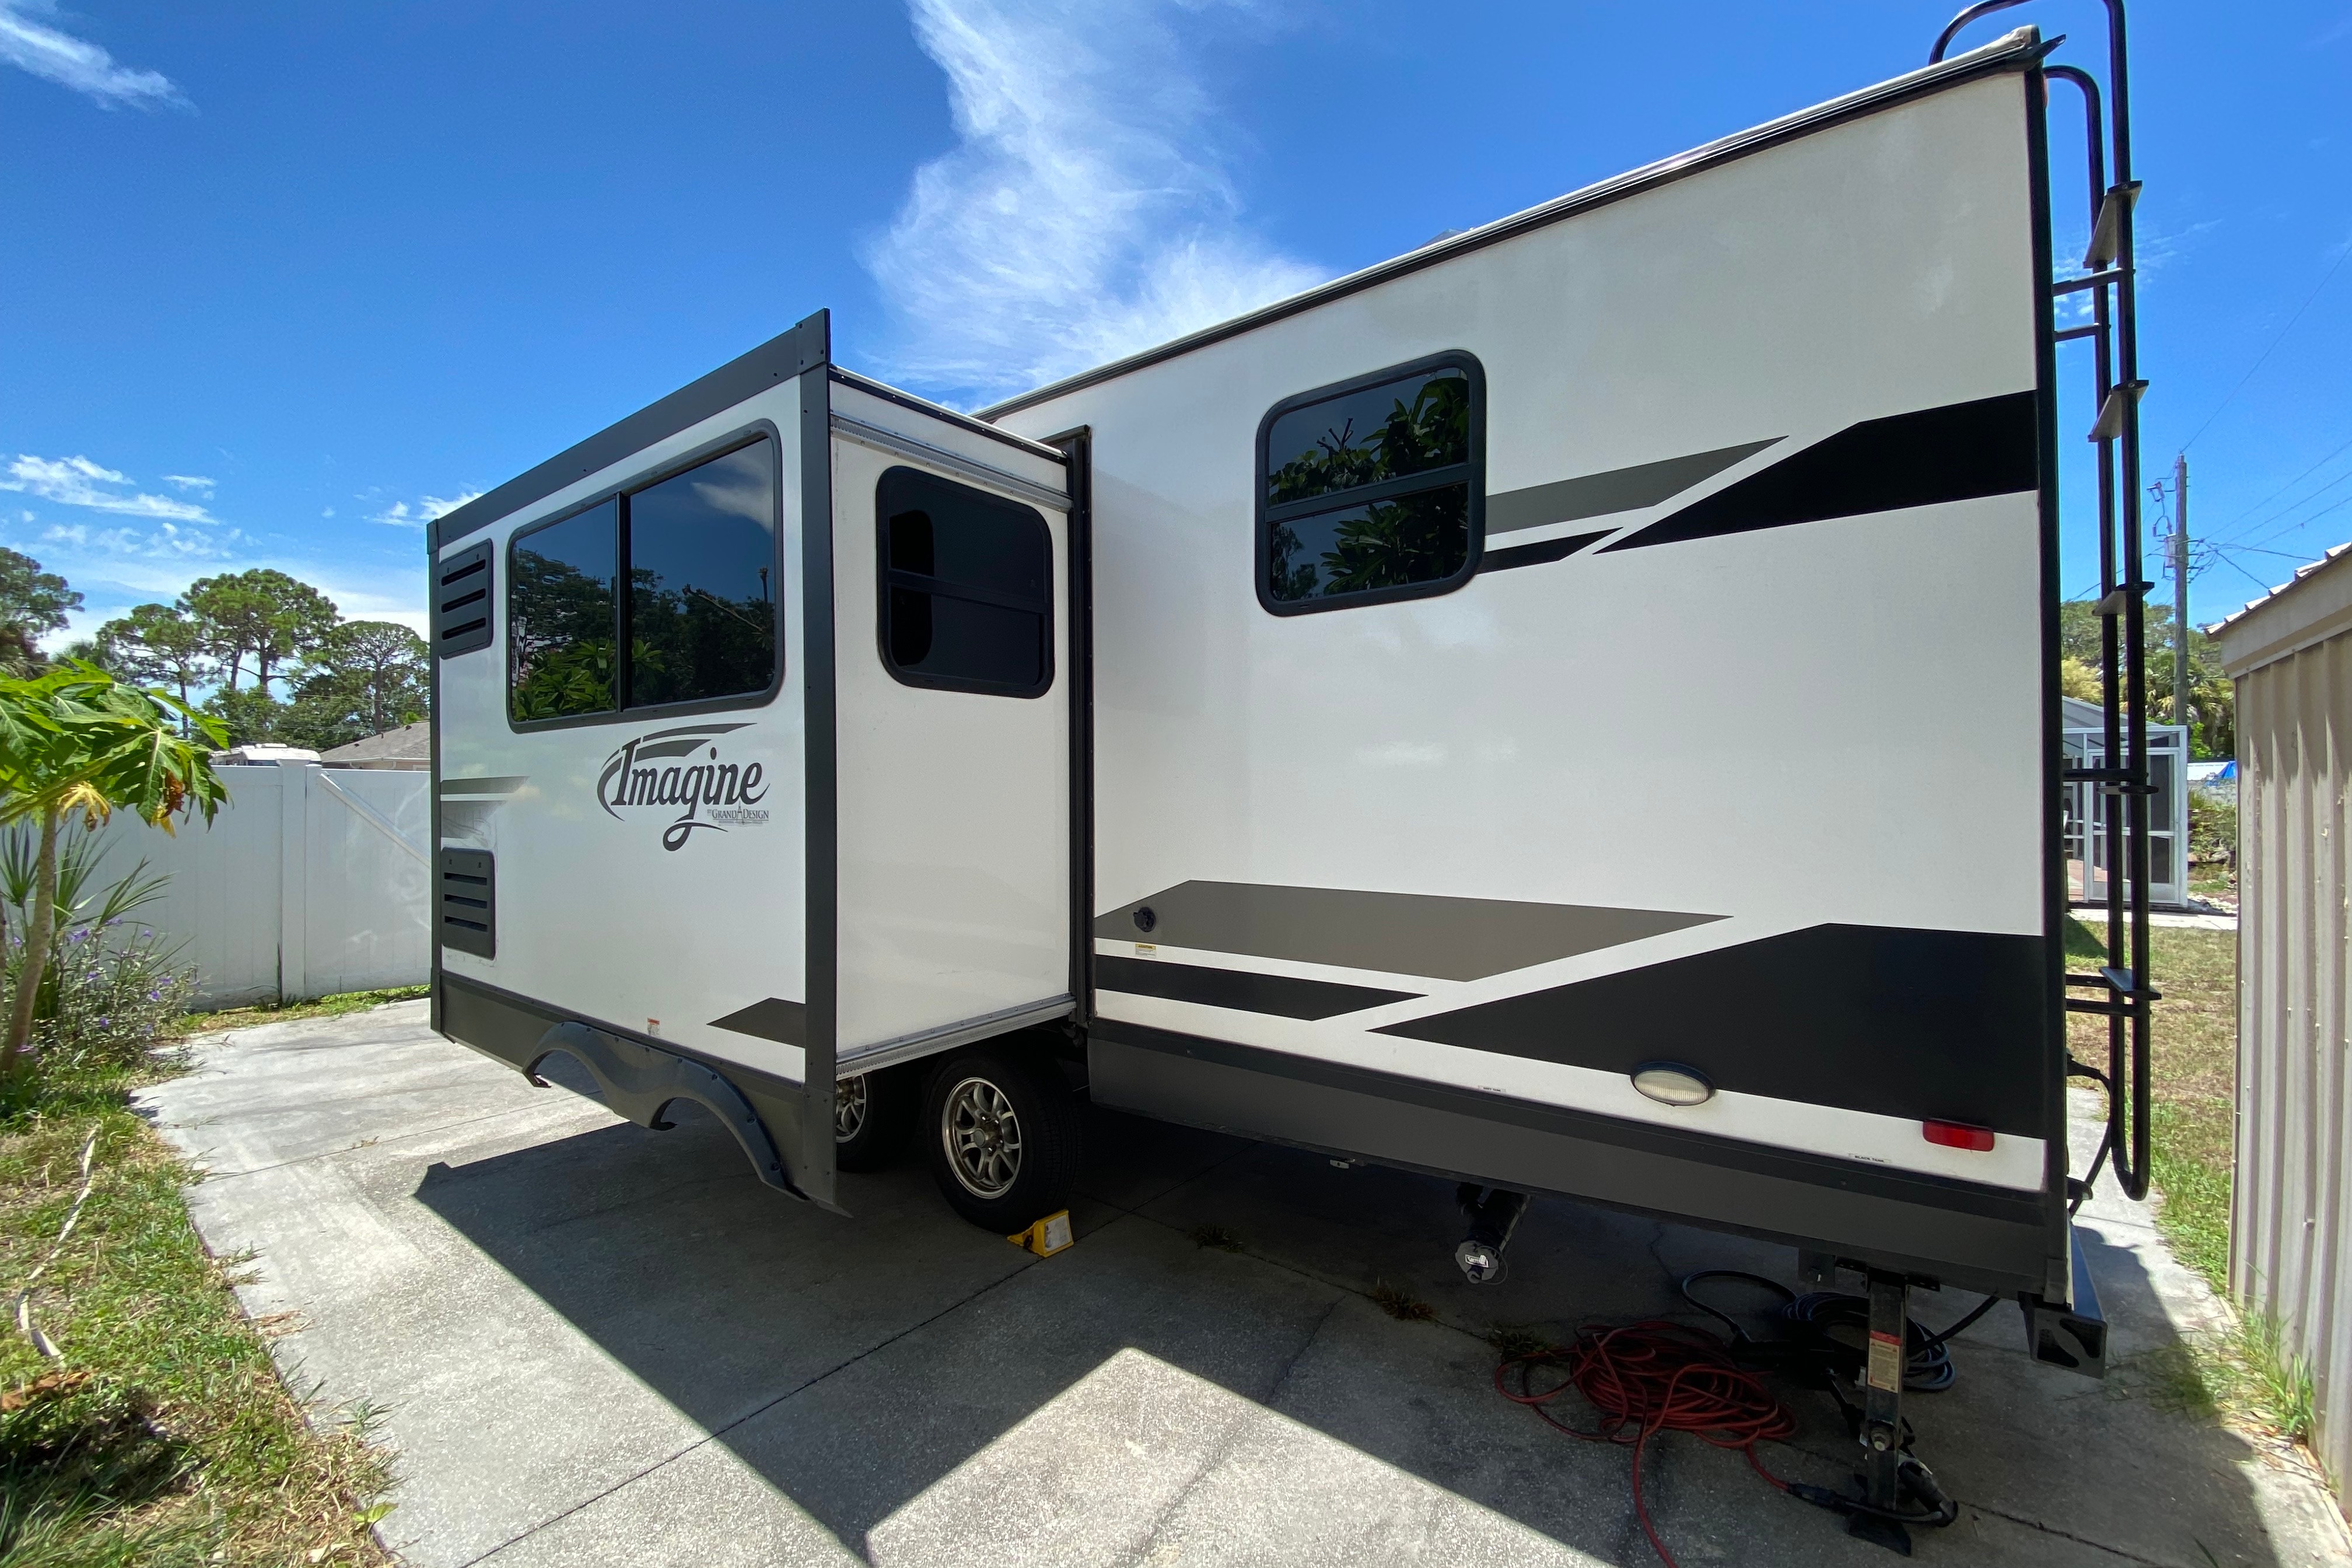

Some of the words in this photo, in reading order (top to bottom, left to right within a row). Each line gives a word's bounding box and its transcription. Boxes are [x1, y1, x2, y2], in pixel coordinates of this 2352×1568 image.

[611, 737, 770, 851] Imagine
[712, 808, 737, 818] GRAND
[743, 808, 769, 819] DESIGN
